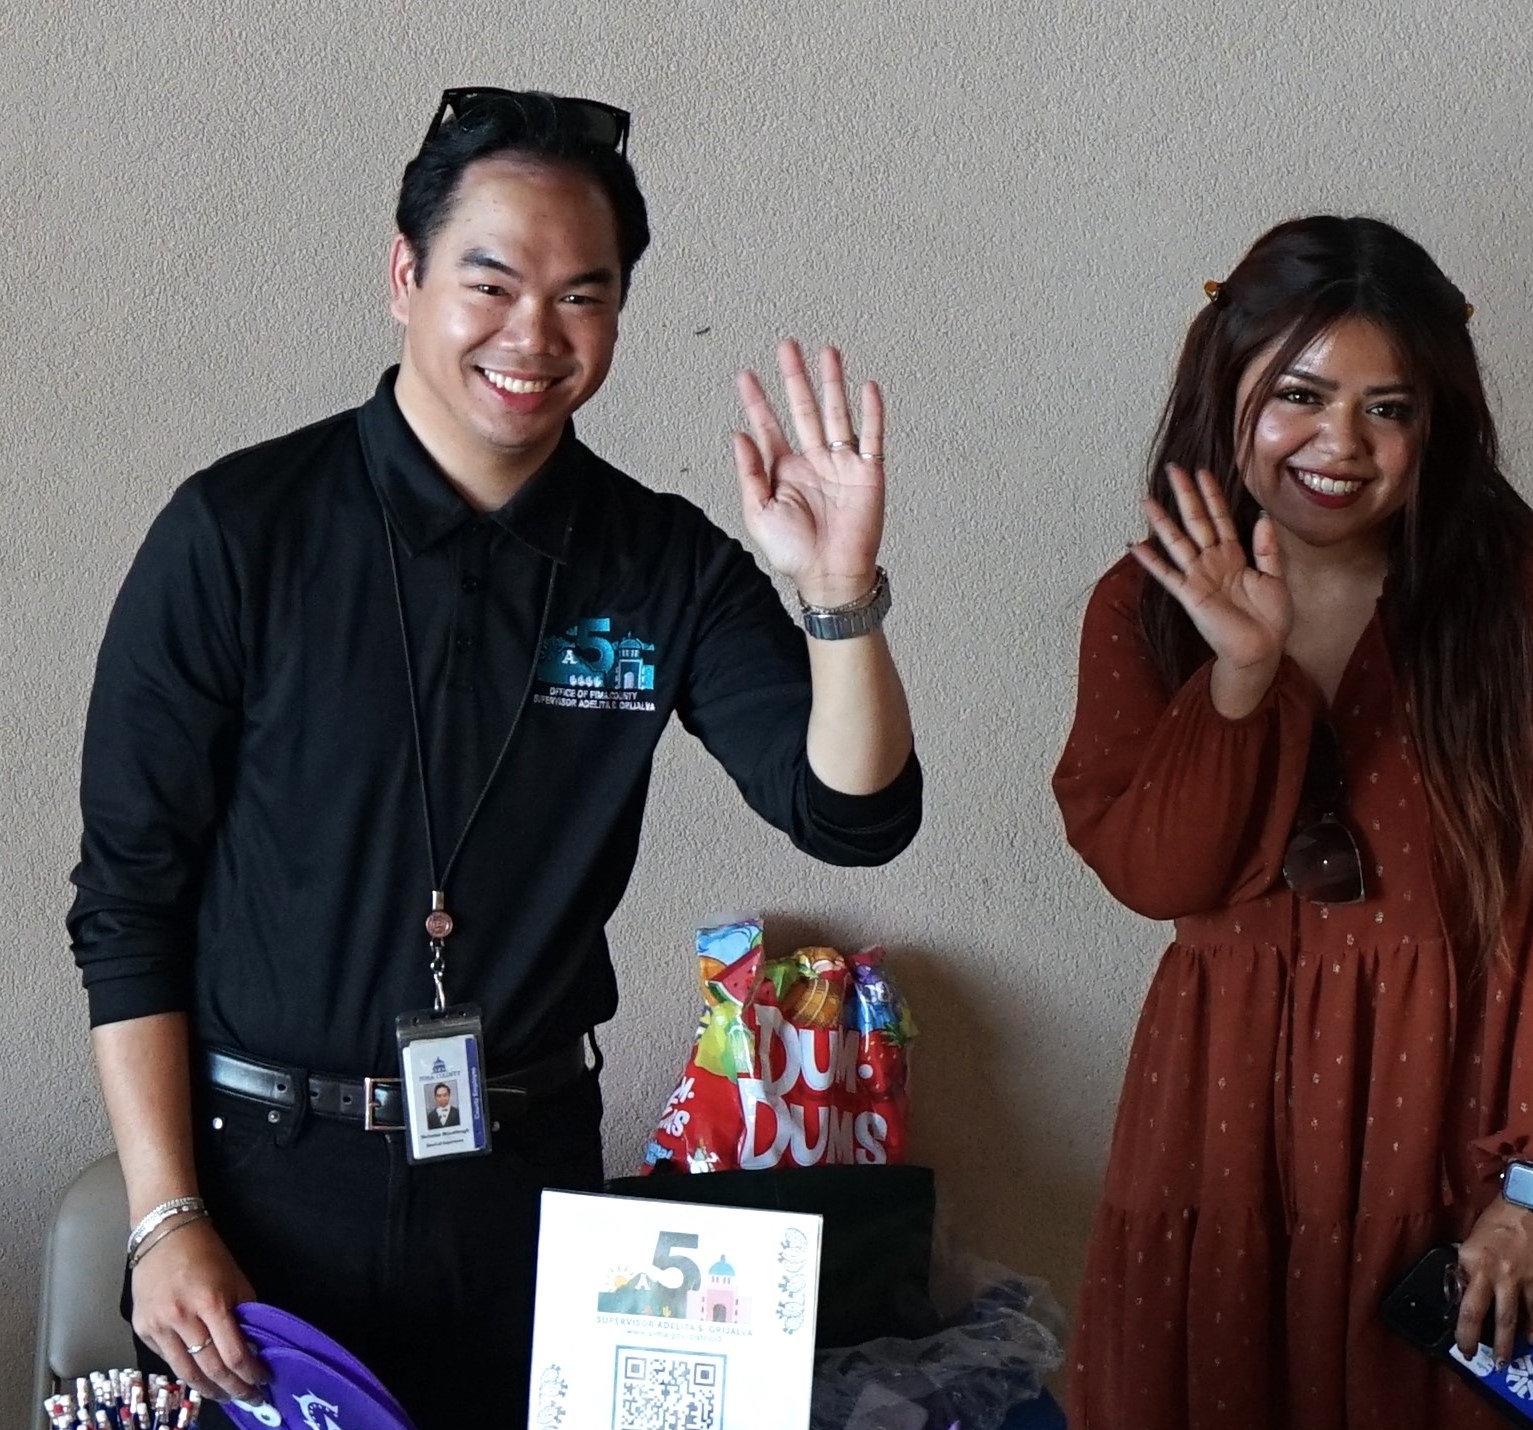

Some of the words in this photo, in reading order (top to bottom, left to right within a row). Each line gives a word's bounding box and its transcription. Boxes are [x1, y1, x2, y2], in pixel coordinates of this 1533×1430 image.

[577, 617, 615, 673] 5
[561, 649, 578, 665] A
[549, 686, 576, 698] OFFICE
[576, 689, 588, 698] OF
[736, 1076, 888, 1170] DUMS
[652, 1230, 703, 1292] 5
[634, 1272, 651, 1291] A
[596, 1315, 656, 1329] SUPERVISOR
[657, 1319, 696, 1333] ADELITA
[709, 1324, 753, 1337] GRIJALVA
